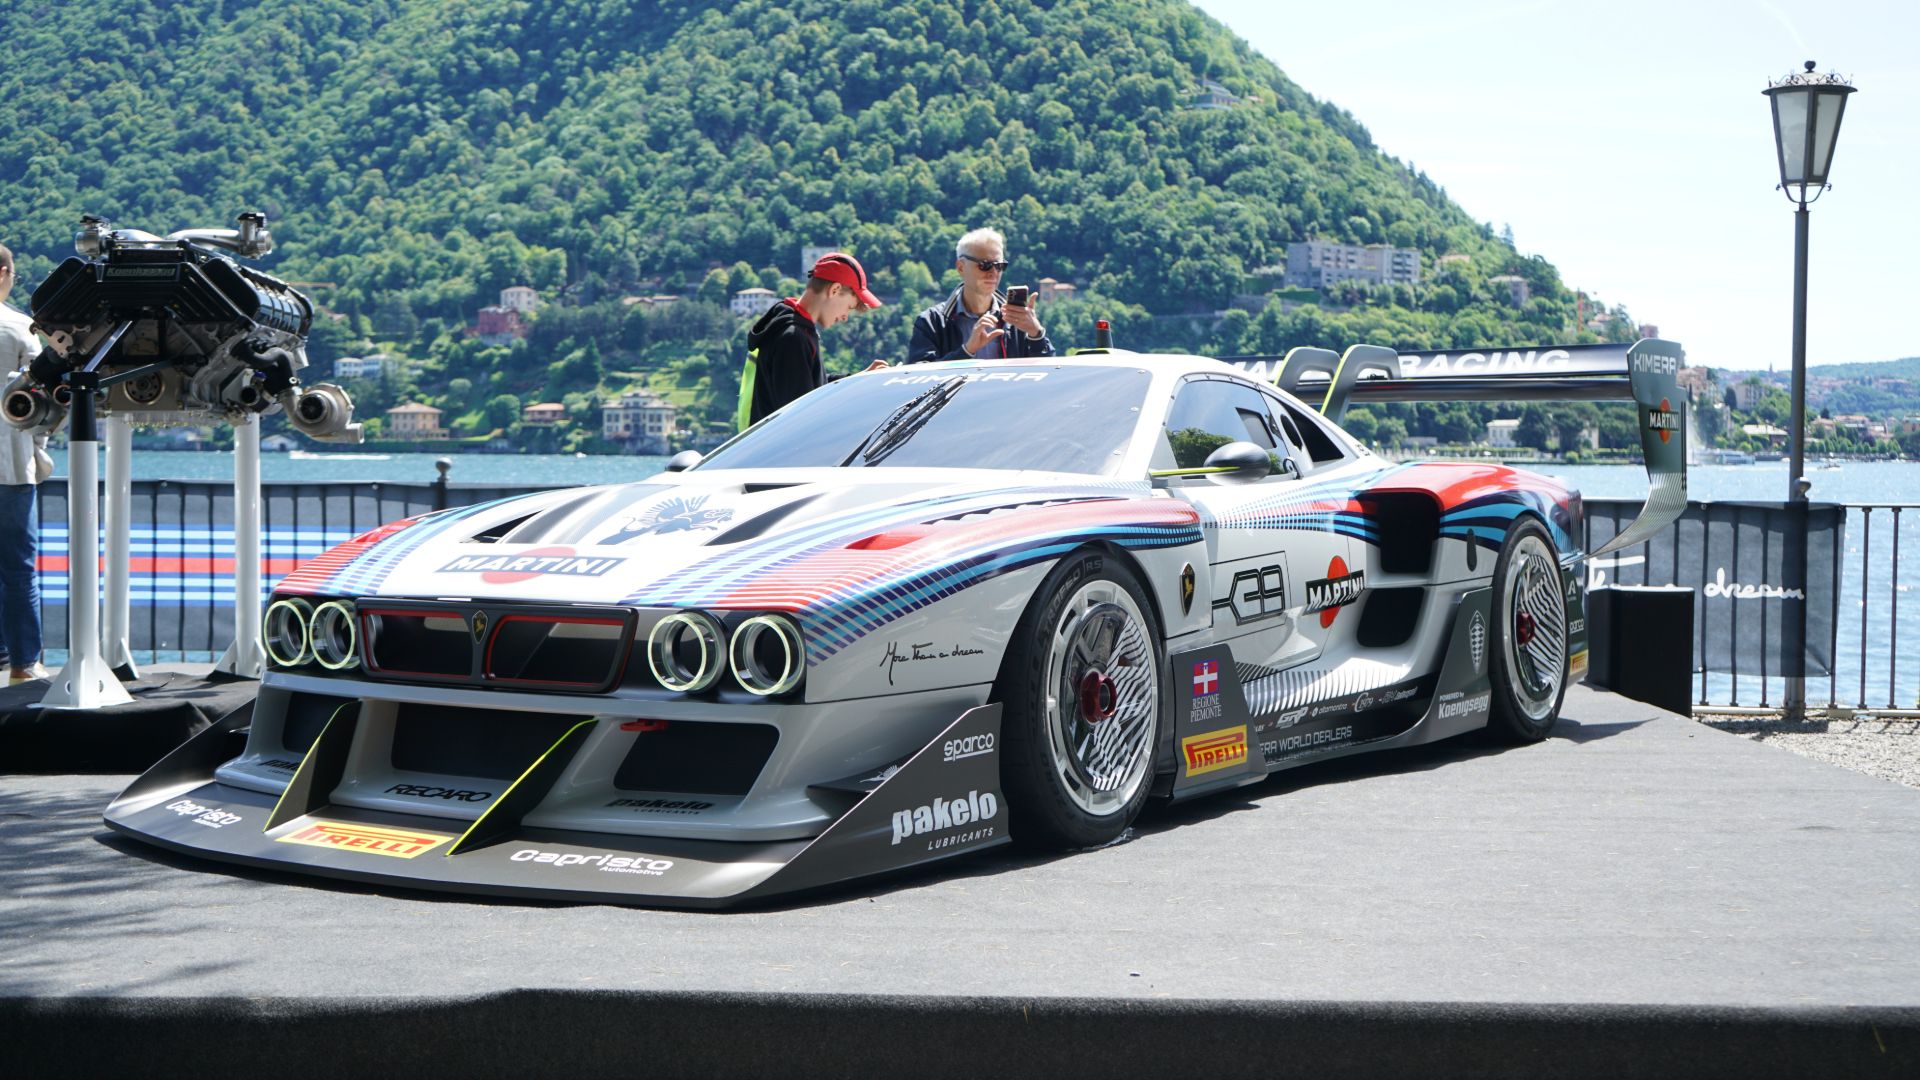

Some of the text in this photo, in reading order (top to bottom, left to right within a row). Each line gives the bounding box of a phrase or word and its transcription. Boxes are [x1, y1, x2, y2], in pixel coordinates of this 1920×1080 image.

[1397, 350, 1570, 378] RACING
[1633, 353, 1677, 376] KIMERA
[1649, 411, 1680, 429] MARTINI
[445, 556, 618, 575] MARTINI
[1307, 576, 1365, 612] MARTINI
[1704, 567, 1805, 600] dream
[912, 642, 936, 660] Than
[952, 644, 984, 657] dream
[1190, 705, 1222, 723] PIEMONTE
[1193, 693, 1220, 711] REGIONE
[1438, 695, 1489, 720] Koenigsegg
[943, 732, 995, 761] sparco
[1279, 733, 1312, 752] WORLD
[1313, 725, 1352, 744] DEALERS
[1185, 732, 1244, 770] PIRELLI
[384, 785, 491, 803] RECARO
[605, 799, 715, 811] pakelo
[166, 800, 242, 825] Capristo
[892, 790, 998, 845] pakelo
[291, 825, 436, 854] PIRELLI
[928, 827, 994, 851] LUBRICANTS
[510, 849, 674, 872] Capristo
[600, 866, 664, 876] Automotive
